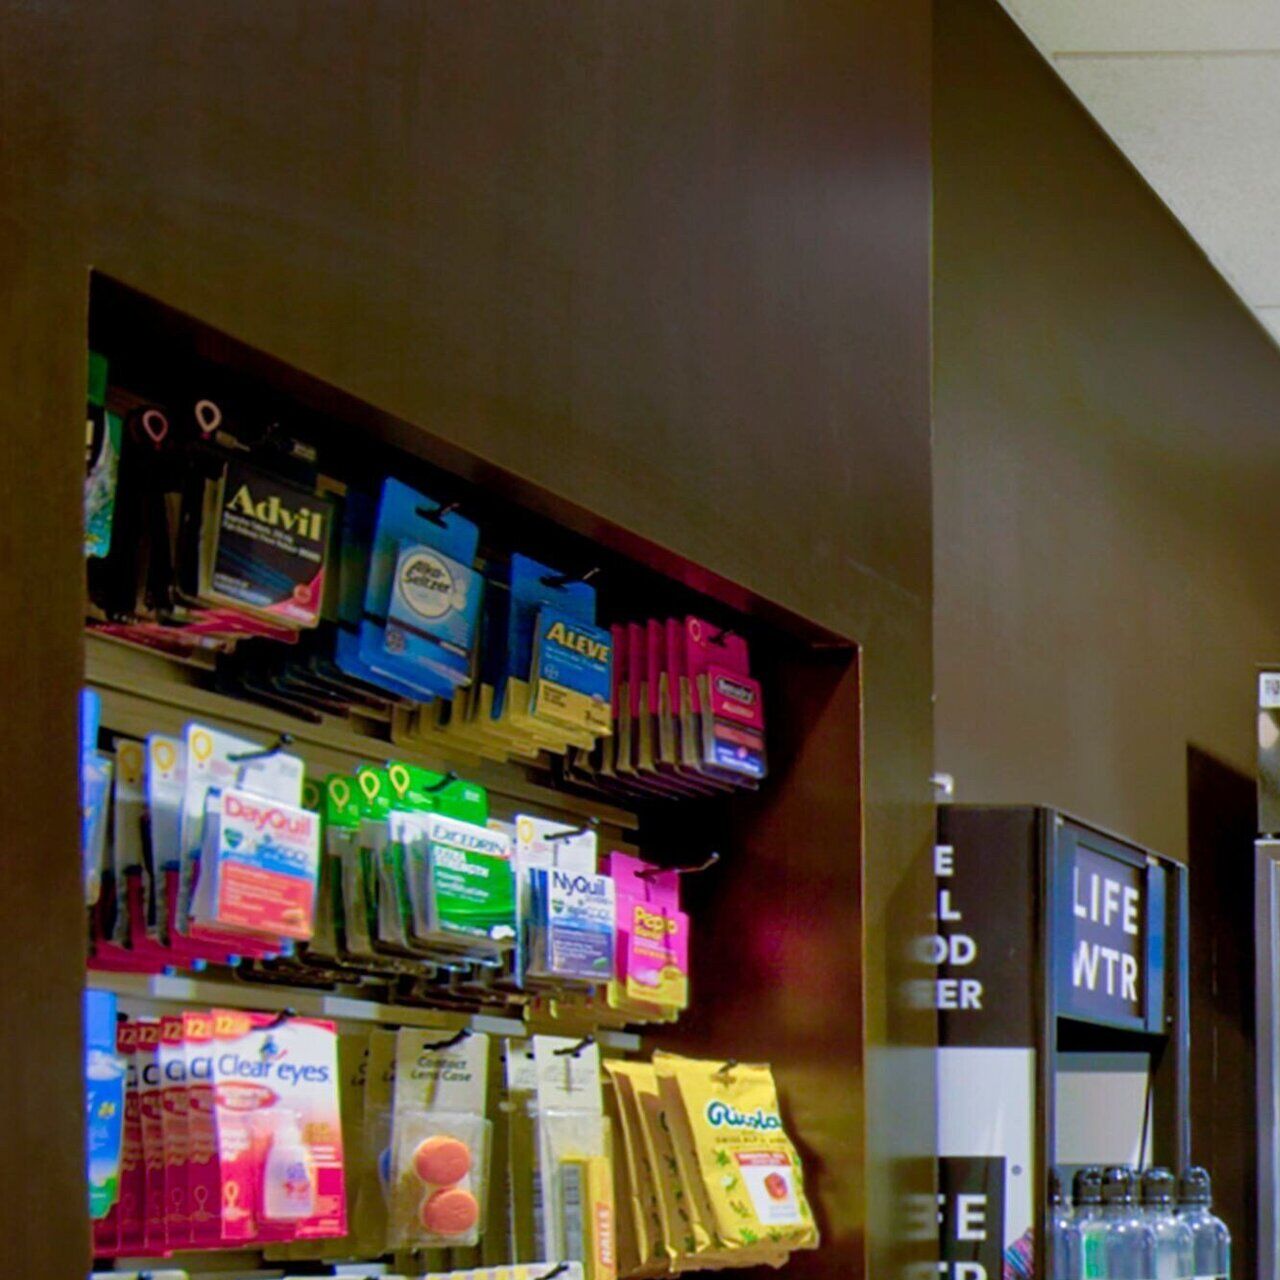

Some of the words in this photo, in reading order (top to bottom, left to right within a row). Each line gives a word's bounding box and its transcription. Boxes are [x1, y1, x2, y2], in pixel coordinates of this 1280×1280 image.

[227, 484, 322, 541] Advil
[547, 622, 610, 662] ALEVE
[225, 795, 311, 837] DayQuil
[553, 871, 606, 897] NyQuil
[1073, 865, 1139, 935] LIFE
[1072, 940, 1138, 1002] WTR
[218, 1053, 271, 1078] Clear
[277, 1063, 329, 1085] eyes
